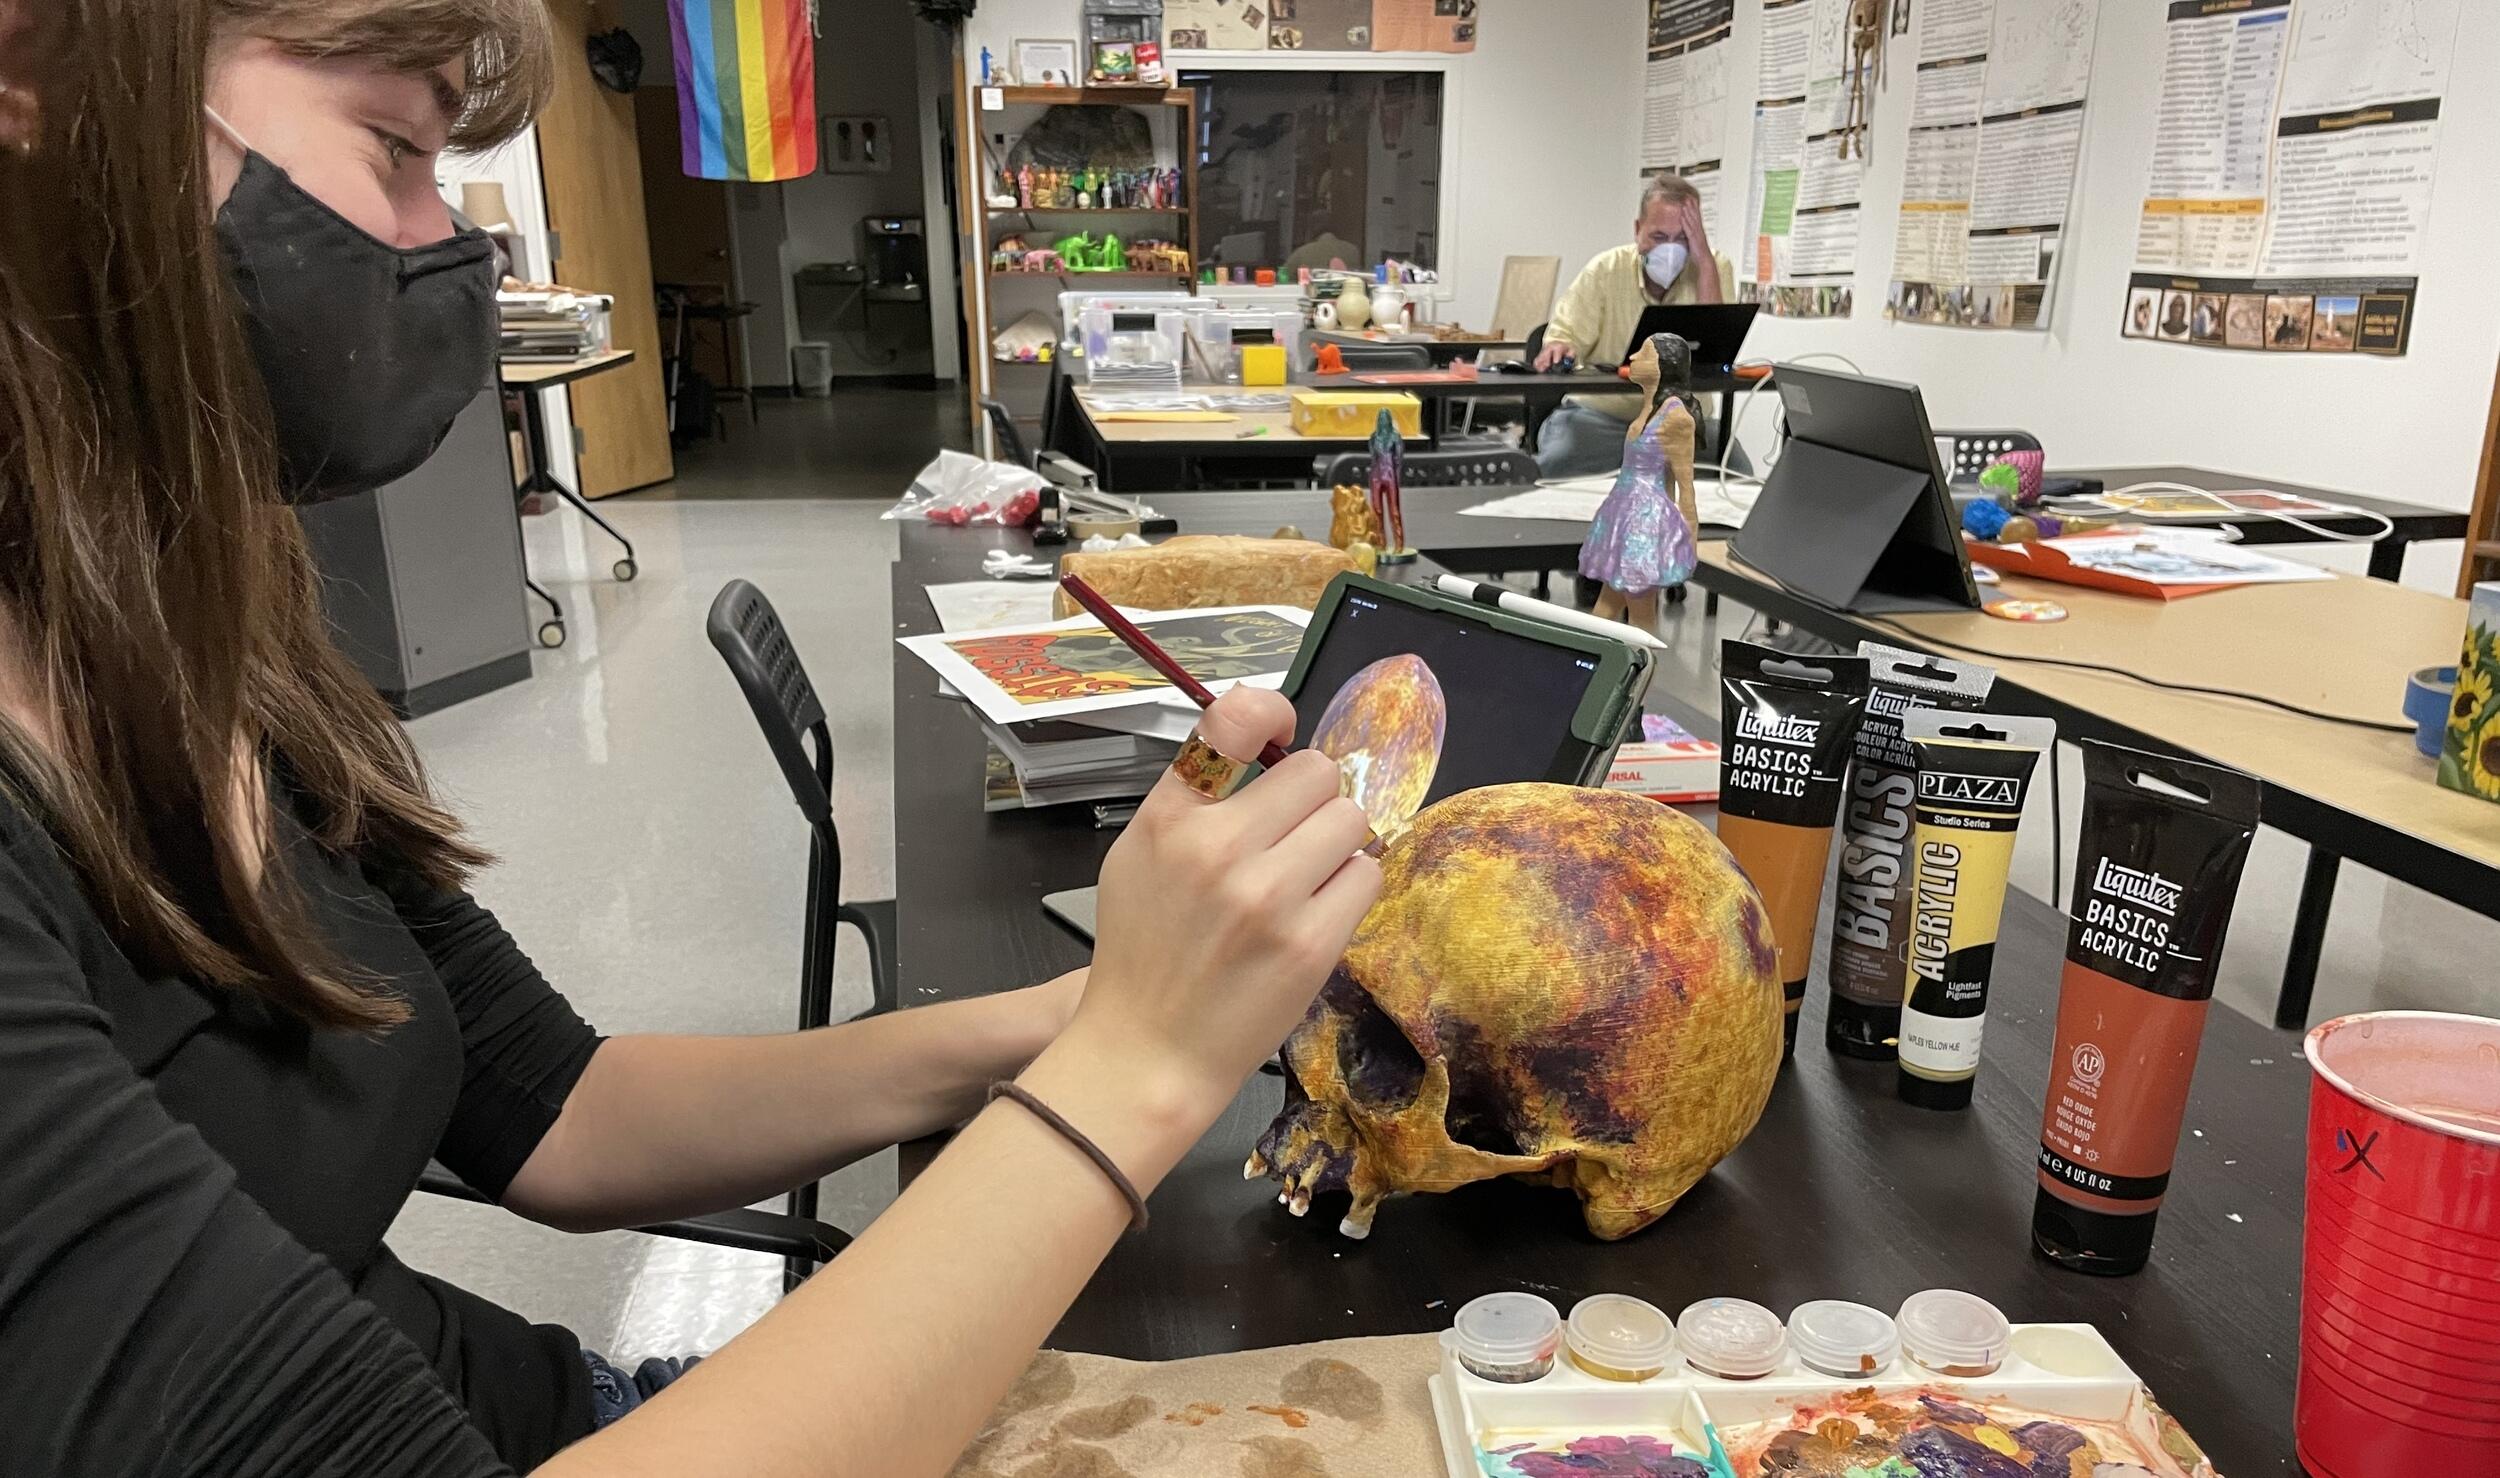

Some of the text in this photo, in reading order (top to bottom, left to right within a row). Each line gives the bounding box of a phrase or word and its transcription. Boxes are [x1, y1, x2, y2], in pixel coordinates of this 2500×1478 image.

[1864, 686, 1938, 719] Liquit
[1736, 706, 1821, 748] Liquitex
[1862, 720, 1899, 737] ACRYLIC
[1856, 744, 1882, 760] COLOR
[1888, 738, 1914, 754] ACRY
[1732, 743, 1812, 776] BASICS
[1729, 768, 1806, 798] ACRYLIC
[1920, 774, 2015, 803] PLAZA
[1933, 814, 1991, 830] Studio Series
[1835, 766, 1916, 950] BASICS
[2092, 856, 2184, 917] Liquitex
[1912, 841, 1961, 983] ACRYLIC
[2085, 898, 2169, 948] BASICS
[2080, 927, 2160, 972] ACRYLIC
[1946, 990, 1982, 1001] Pigments
[1948, 981, 1982, 992] Lightfast
[1925, 1039, 1948, 1051] YELLOW
[1948, 1042, 1961, 1052] HUE
[2077, 1053, 2099, 1073] AP
[2062, 1096, 2094, 1118] RED OXIDE
[2074, 1129, 2091, 1142] ROJO
[2075, 1115, 2097, 1132] OXYDE
[2065, 1165, 2072, 1179] 4
[2073, 1166, 2087, 1184] US
[2088, 1173, 2097, 1188] fl
[2098, 1178, 2113, 1192] oz
